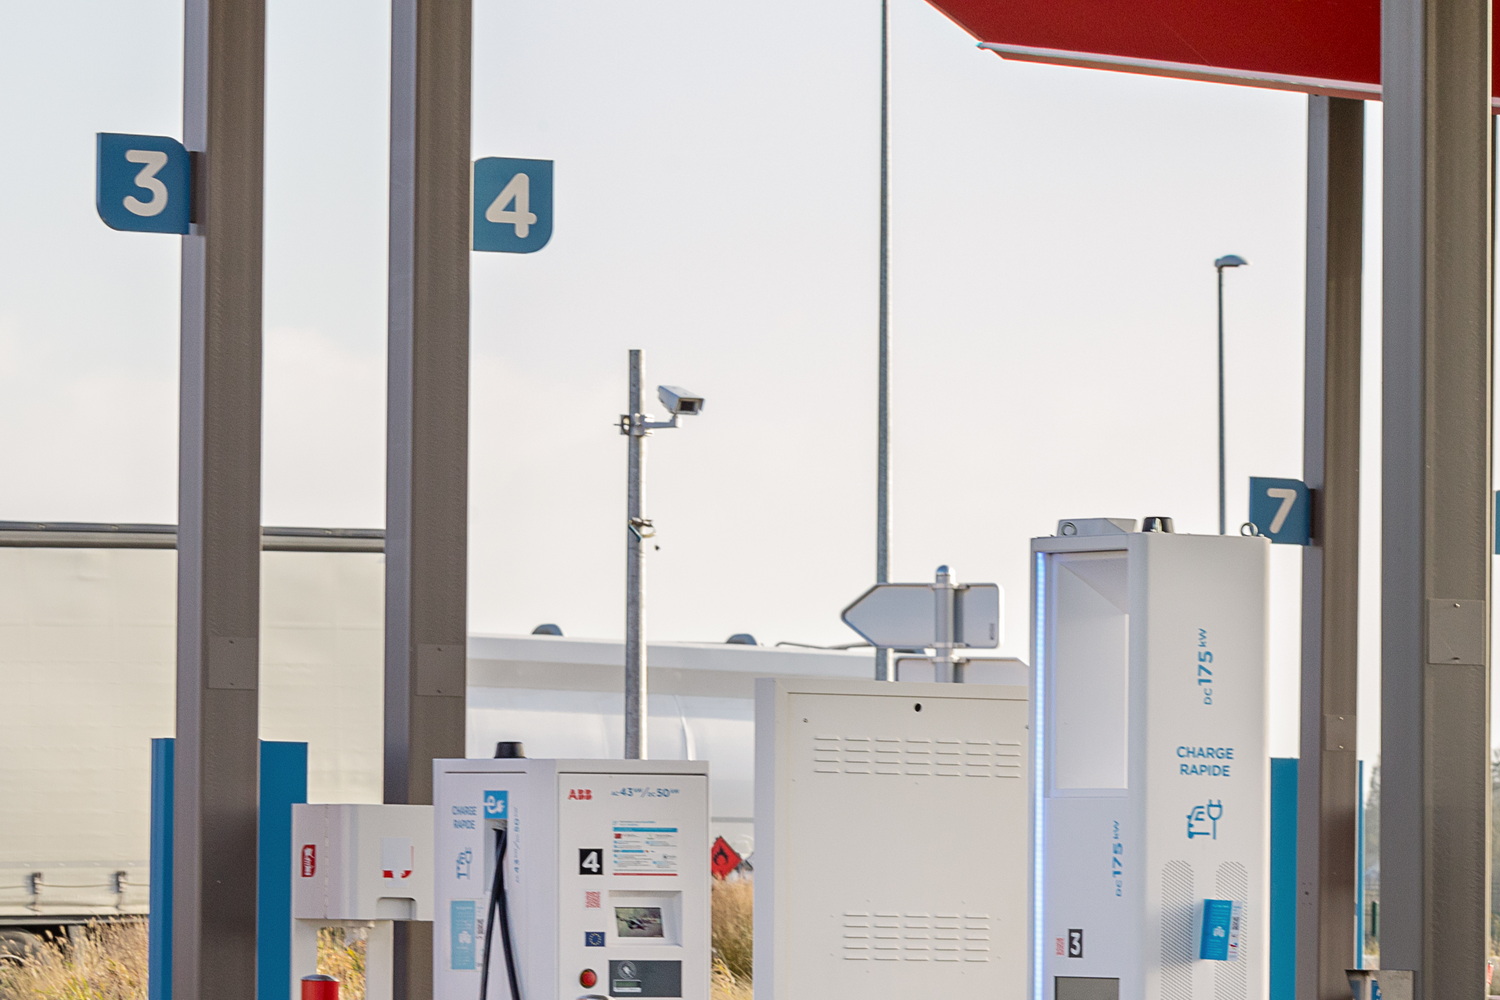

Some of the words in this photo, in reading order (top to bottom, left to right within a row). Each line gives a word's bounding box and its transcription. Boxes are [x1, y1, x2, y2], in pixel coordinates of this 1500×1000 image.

[123, 149, 168, 217] 3
[485, 172, 537, 239] 4
[1266, 487, 1297, 534] 7
[1197, 651, 1213, 686] 175
[1203, 688, 1213, 706] DC
[1176, 746, 1234, 760] CHARGE
[1179, 763, 1231, 777] RAPIDE
[568, 789, 593, 800] ABB
[582, 851, 600, 873] 4
[1070, 932, 1081, 955] 3
